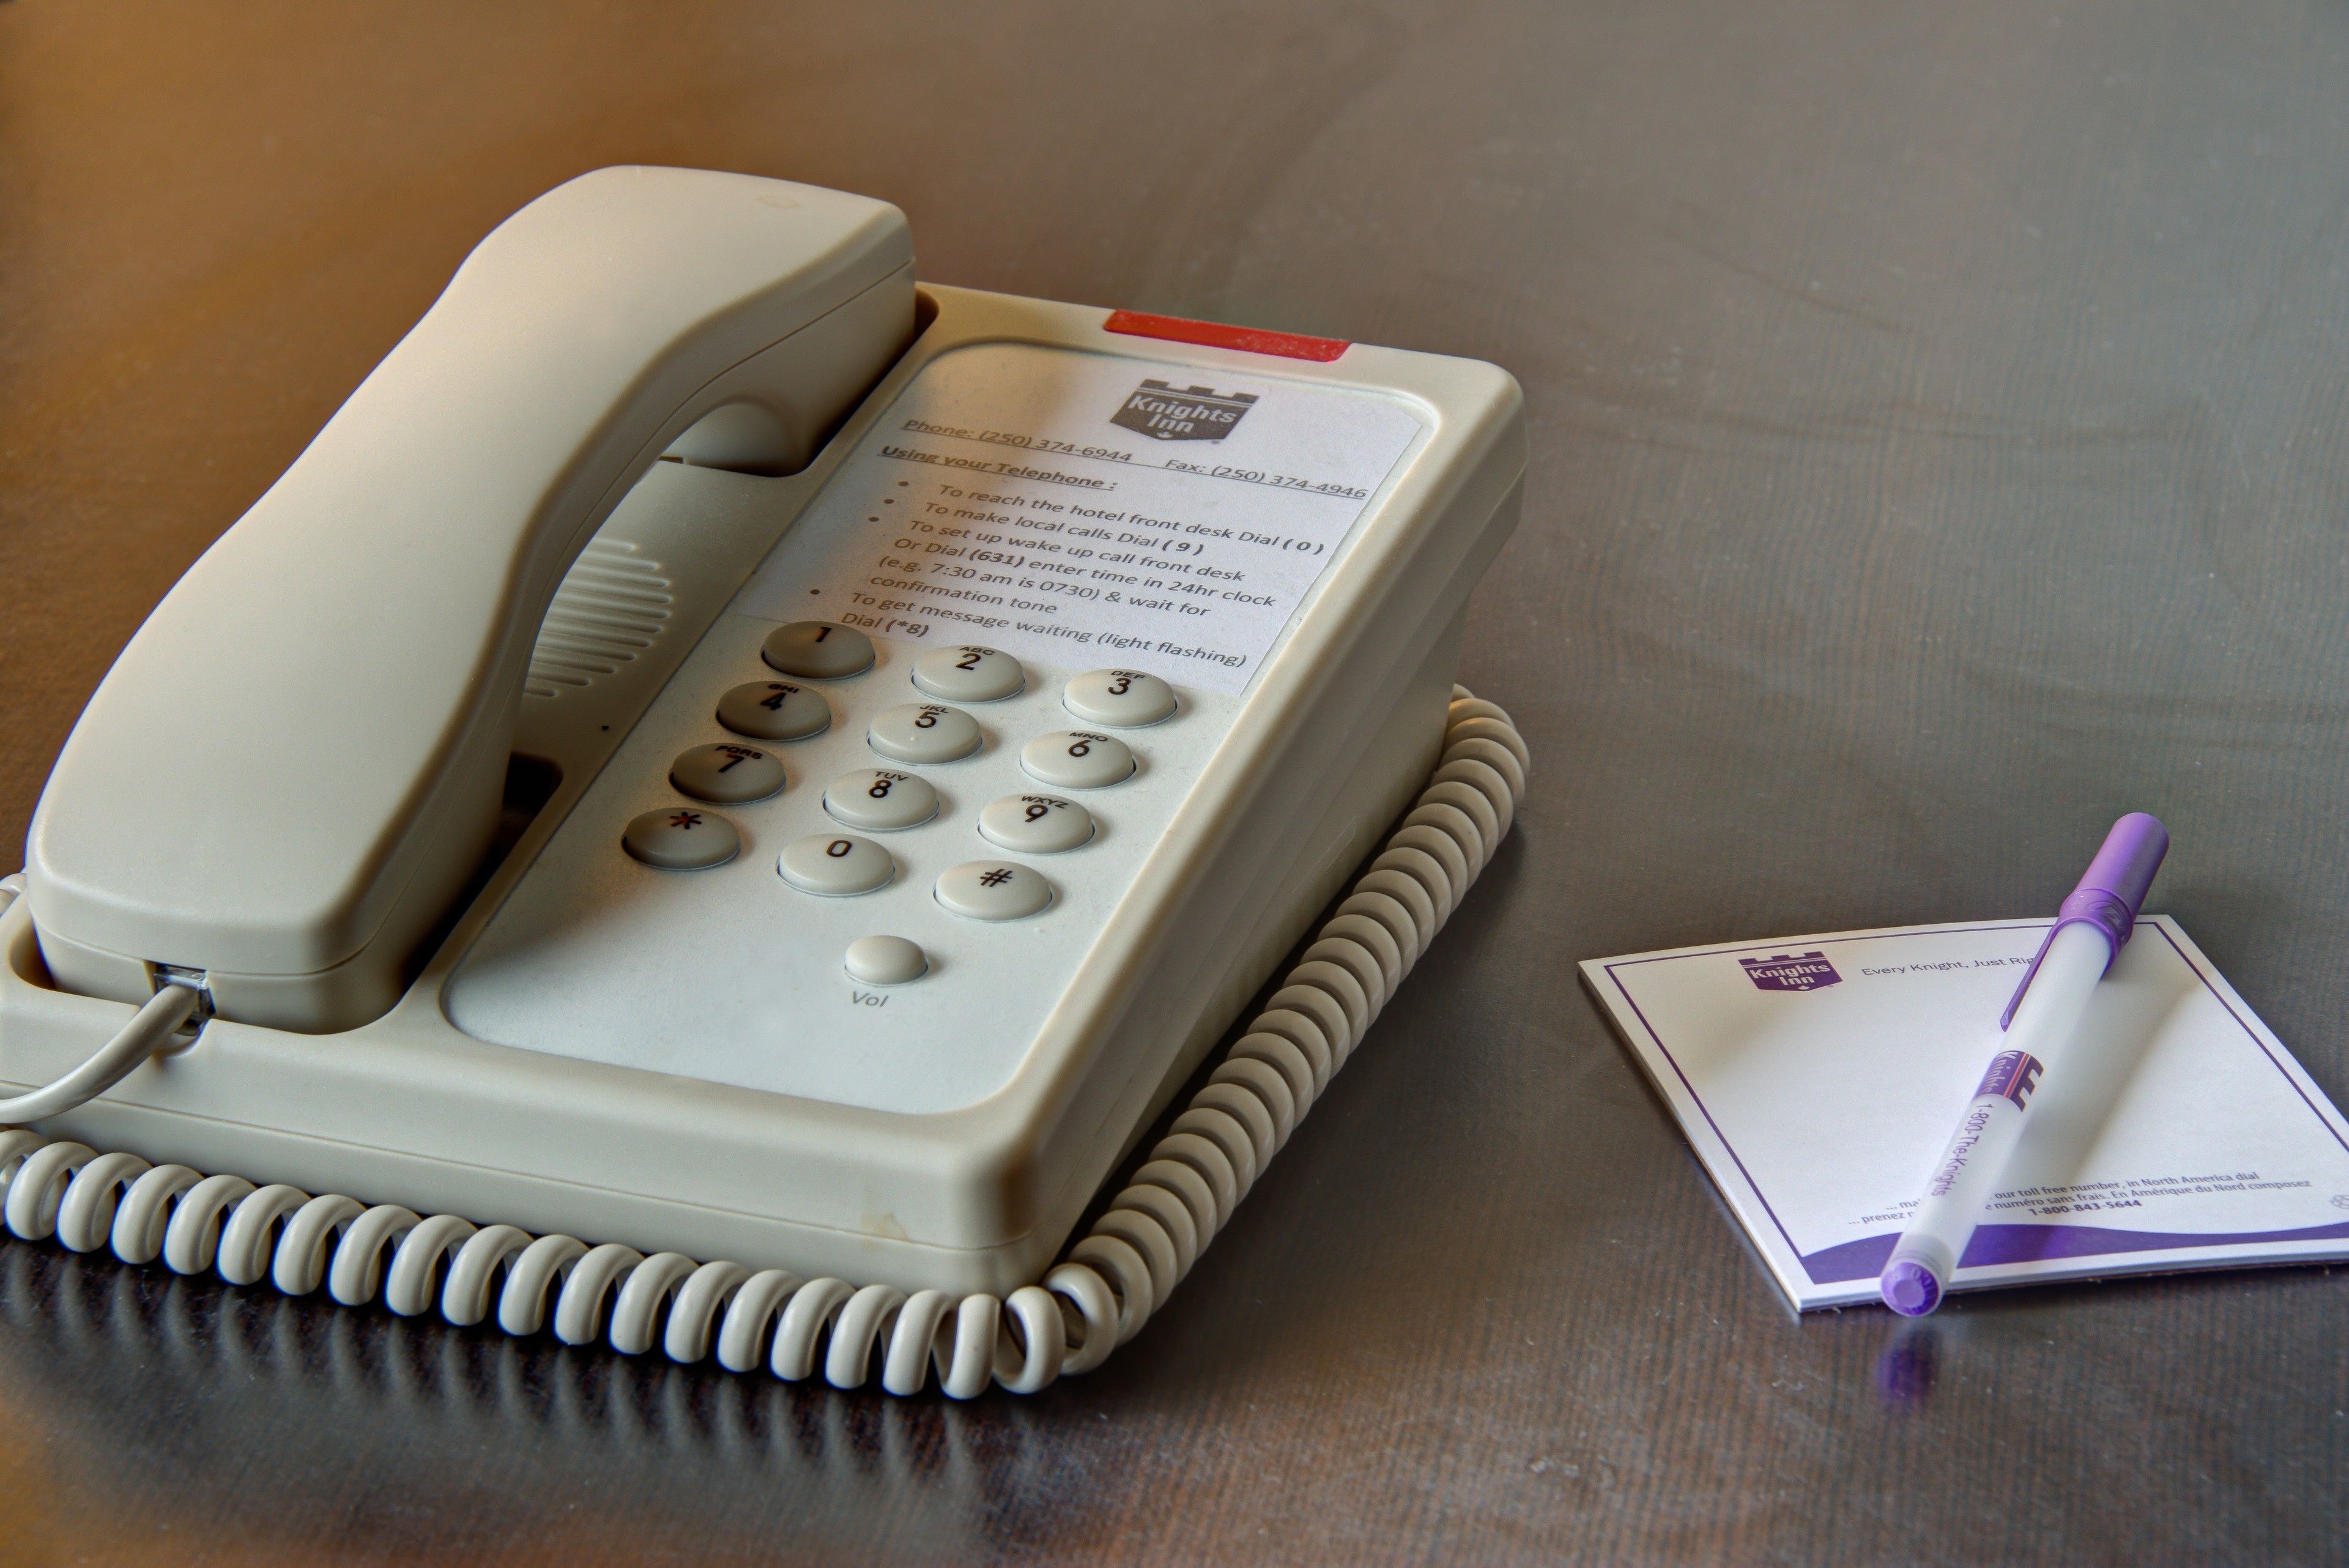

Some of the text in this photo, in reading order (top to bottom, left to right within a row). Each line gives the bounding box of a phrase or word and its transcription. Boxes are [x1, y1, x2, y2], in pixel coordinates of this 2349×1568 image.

[1127, 395, 1238, 423] Knights
[1148, 414, 1194, 433] Inn
[881, 445, 940, 463] Using
[943, 457, 993, 469] your
[904, 420, 1368, 498] Phone: (250) 374-6944 Fax: (250) 374-4946
[926, 502, 949, 515] To
[953, 510, 1009, 524] make
[1015, 517, 1064, 532] local
[1068, 526, 1113, 540] calls
[1118, 533, 1159, 547] Dial
[940, 485, 963, 497] To
[968, 492, 1025, 506] reach
[1033, 500, 1064, 512] the
[1070, 505, 1124, 521] hotel
[1130, 515, 1182, 530] front
[1186, 524, 1234, 538] desk
[1238, 532, 1280, 546] Dial
[910, 520, 1245, 582] To set up wake up call front desk
[895, 538, 1276, 606] Or Dial (631) enter time in 24hr clock
[879, 555, 1211, 616] (e.g. 7:30 am is 0730) & wait for
[870, 577, 1057, 614] confirmation tone
[841, 613, 884, 628] Dial
[815, 626, 832, 642] 1
[852, 592, 1247, 668] To get message waiting (light flashing)
[959, 647, 996, 655] ABC
[956, 653, 981, 671] 2
[1111, 671, 1146, 679] DEF
[768, 683, 800, 693] GHI
[1108, 678, 1131, 695] 3
[760, 693, 787, 710] 4
[919, 705, 949, 715] JKL
[915, 712, 939, 729] 5
[1069, 732, 1108, 742] MNO
[716, 745, 763, 759] PQRS
[1068, 740, 1089, 758] 6
[718, 754, 744, 773] 7
[875, 771, 908, 782] TUV
[869, 779, 892, 798] 8
[1021, 795, 1069, 809] WXYZ
[1025, 804, 1048, 823] 9
[826, 839, 853, 858] 0
[1750, 964, 1831, 979] Knights
[1861, 967, 1905, 975] Every
[1910, 961, 1969, 971] Knight,
[1779, 976, 1816, 986] Inn
[852, 991, 889, 1008] Vol
[2017, 1187, 2040, 1197] toll
[2042, 1184, 2068, 1194] free
[2142, 1177, 2178, 1186] North
[2181, 1174, 2233, 1184] America
[2236, 1172, 2260, 1181] dial
[1861, 1213, 1906, 1224] prenez
[1994, 1199, 2044, 1209] numéro
[2047, 1195, 2075, 1204] sans
[2131, 1184, 2192, 1197] Amérique
[2195, 1183, 2213, 1193] du
[2214, 1183, 2246, 1192] Nord
[2248, 1180, 2313, 1190] composez
